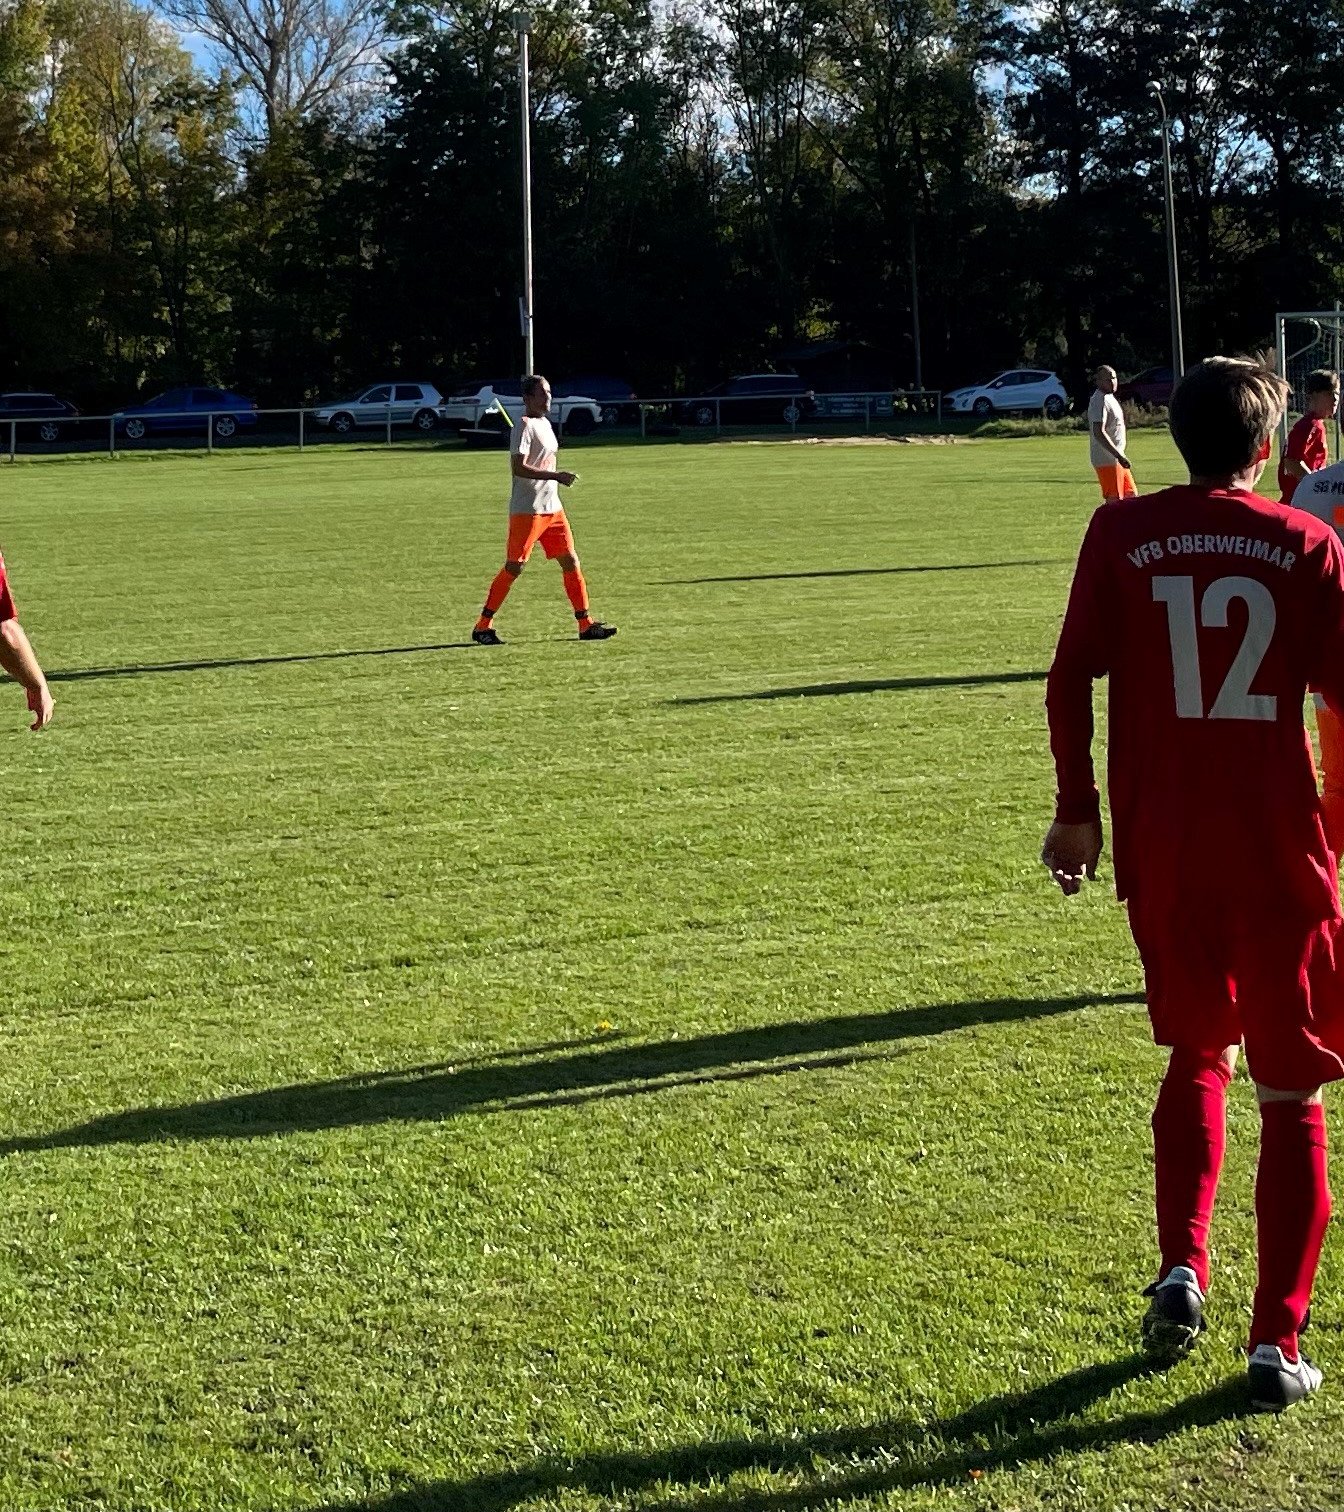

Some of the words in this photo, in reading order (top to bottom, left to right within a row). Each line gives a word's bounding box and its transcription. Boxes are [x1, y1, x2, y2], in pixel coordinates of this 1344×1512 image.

[1126, 540, 1164, 569] VFB
[1166, 534, 1296, 572] OBERWEIMAR
[1151, 575, 1277, 721] 12
